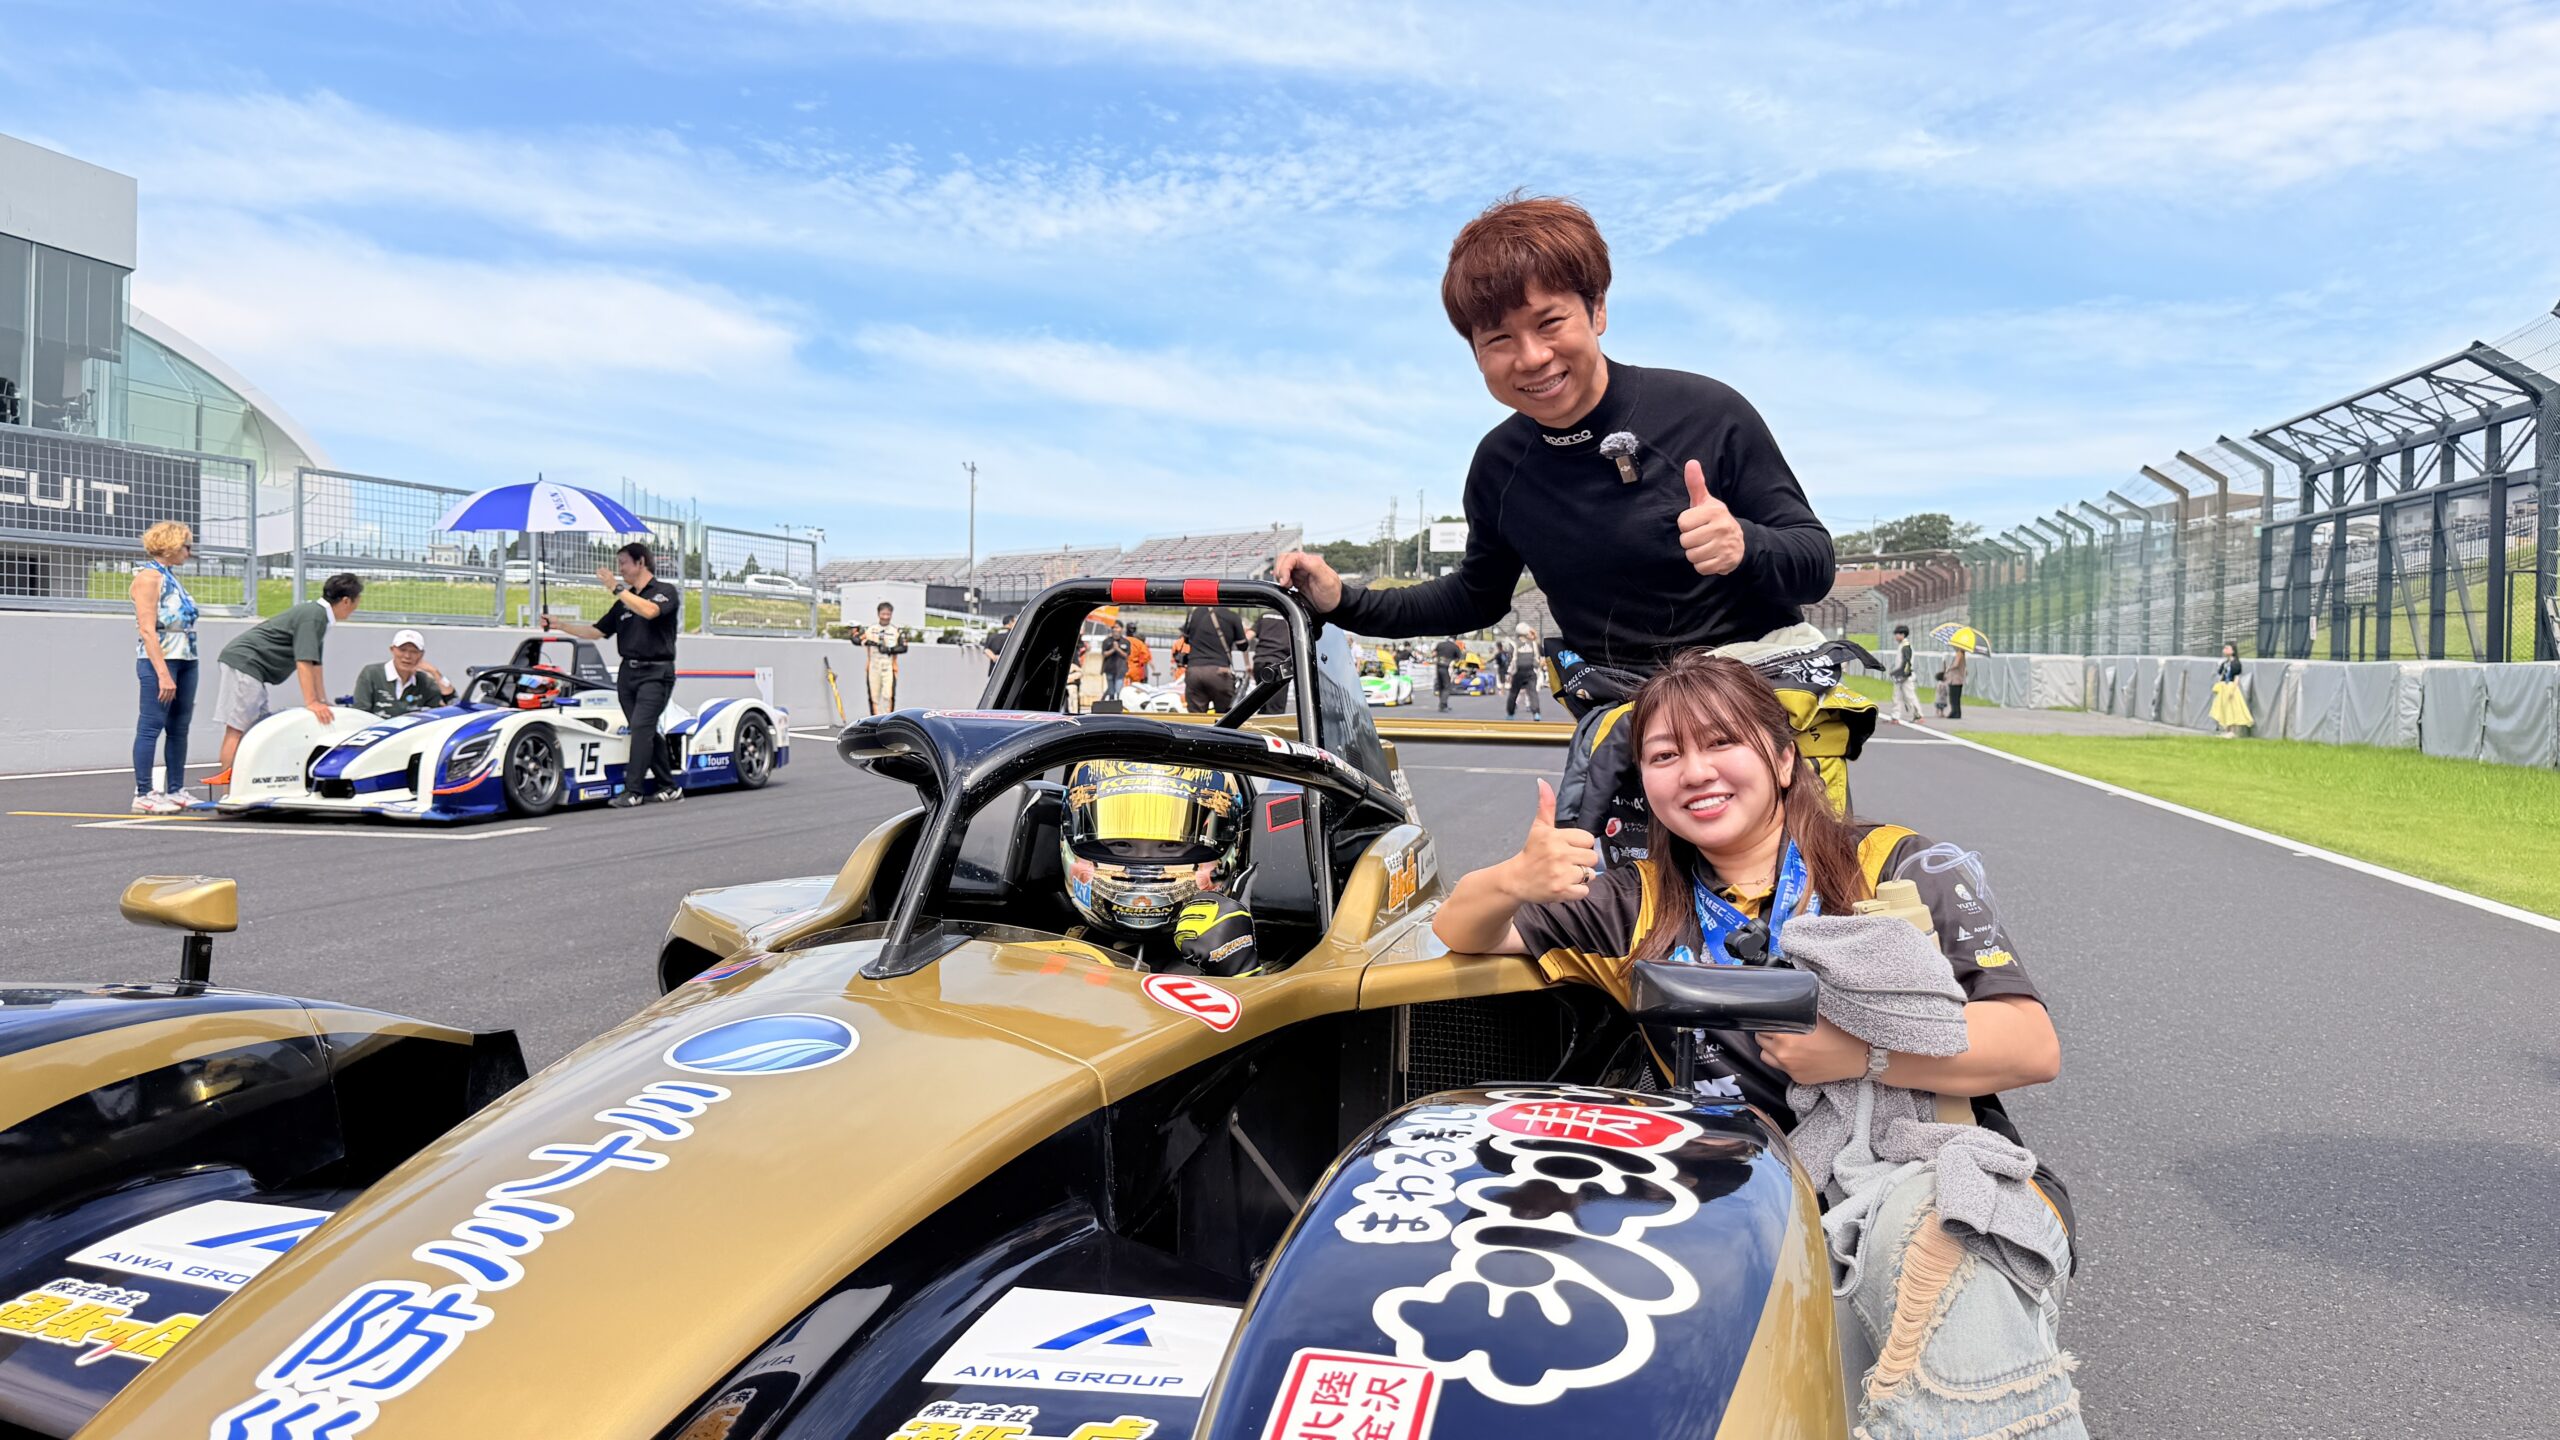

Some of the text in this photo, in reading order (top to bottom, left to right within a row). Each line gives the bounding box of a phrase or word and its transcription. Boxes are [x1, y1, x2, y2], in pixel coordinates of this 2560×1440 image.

[579, 742, 601, 776] 15
[707, 754, 730, 766] fours
[97, 1250, 172, 1271] AIWA
[48, 1280, 143, 1306] 株式会社
[953, 1365, 1184, 1388] AIWA GROUP
[922, 1403, 1036, 1423] 株式会社
